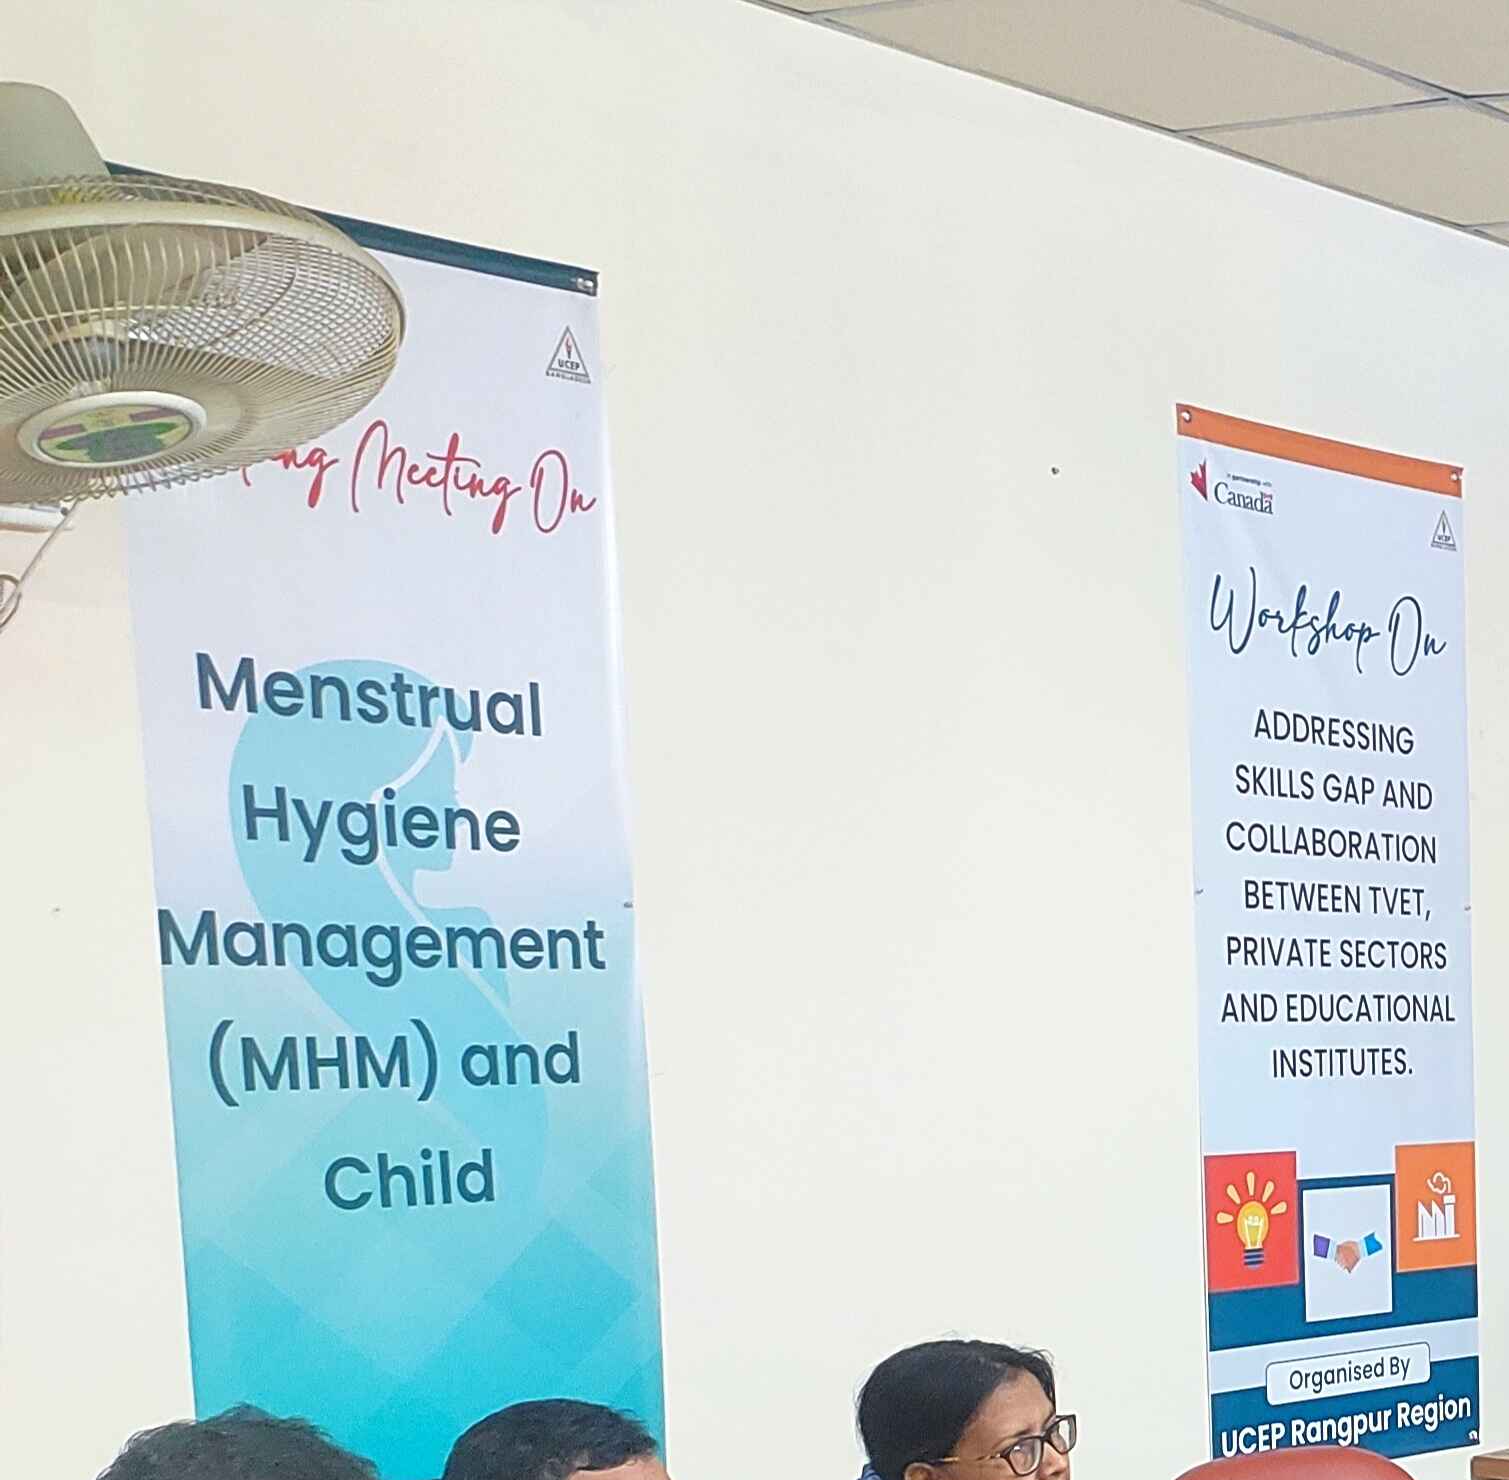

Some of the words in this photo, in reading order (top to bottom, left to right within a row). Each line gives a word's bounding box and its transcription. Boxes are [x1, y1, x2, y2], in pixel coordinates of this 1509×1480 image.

[353, 420, 522, 534] Meeting
[531, 450, 597, 533] On
[1213, 481, 1273, 515] Canada
[1210, 566, 1380, 674] Workshop
[1388, 596, 1447, 676] On
[196, 652, 543, 736] Menstrual
[1254, 708, 1415, 755] ADDRESSING
[1235, 764, 1314, 800] SKILLS
[1323, 773, 1375, 806] GAP
[1383, 779, 1433, 810] AND
[242, 784, 521, 865] Hygiene
[1226, 821, 1437, 864] COLLABORATION
[1244, 879, 1361, 914] BETWEEN
[1369, 886, 1432, 921] TVET,
[160, 908, 607, 986] Management
[1226, 936, 1332, 968] PRIVATE
[1340, 940, 1447, 970] SECTORS
[1221, 993, 1278, 1023] AND
[1286, 993, 1456, 1023] EDUCATIONAL
[211, 1018, 438, 1108] (MHM)
[462, 1031, 582, 1087] and
[1272, 1047, 1414, 1078] INSTITUTES.
[324, 1148, 496, 1211] Child
[1289, 1357, 1384, 1394] Organised
[1389, 1356, 1410, 1379] By
[1221, 1422, 1285, 1458] UCEP
[1291, 1409, 1392, 1447] Rangpur
[1397, 1394, 1471, 1432] Region
